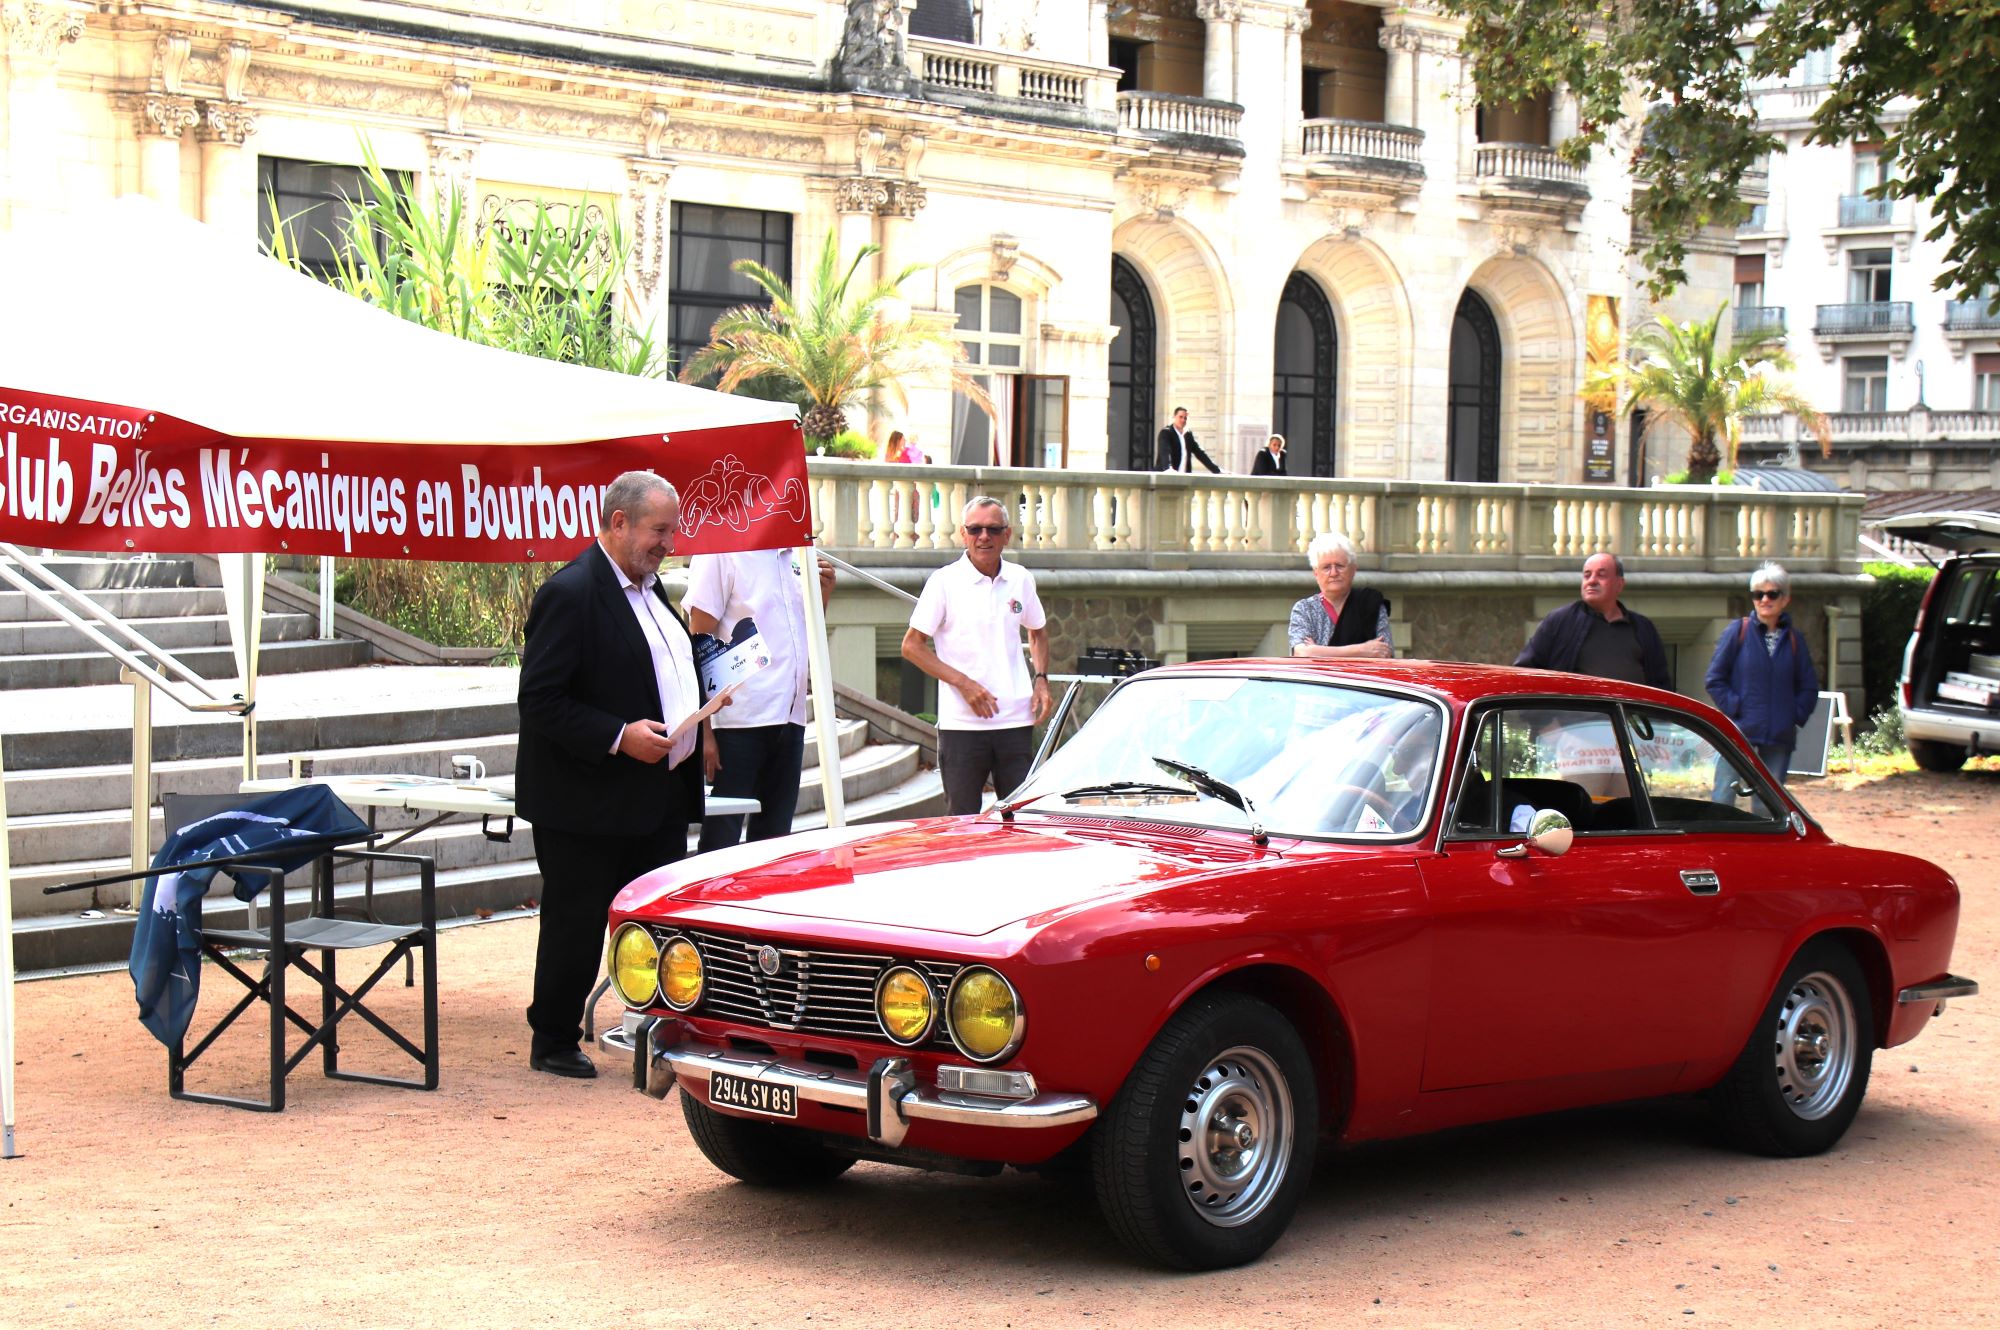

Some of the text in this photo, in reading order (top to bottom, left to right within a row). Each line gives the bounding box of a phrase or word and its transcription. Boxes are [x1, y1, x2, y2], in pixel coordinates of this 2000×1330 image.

[78, 442, 191, 529] Belles
[200, 448, 407, 553] Mécaniques
[416, 480, 454, 537] en
[715, 1076, 791, 1113] 2944 SV 89
